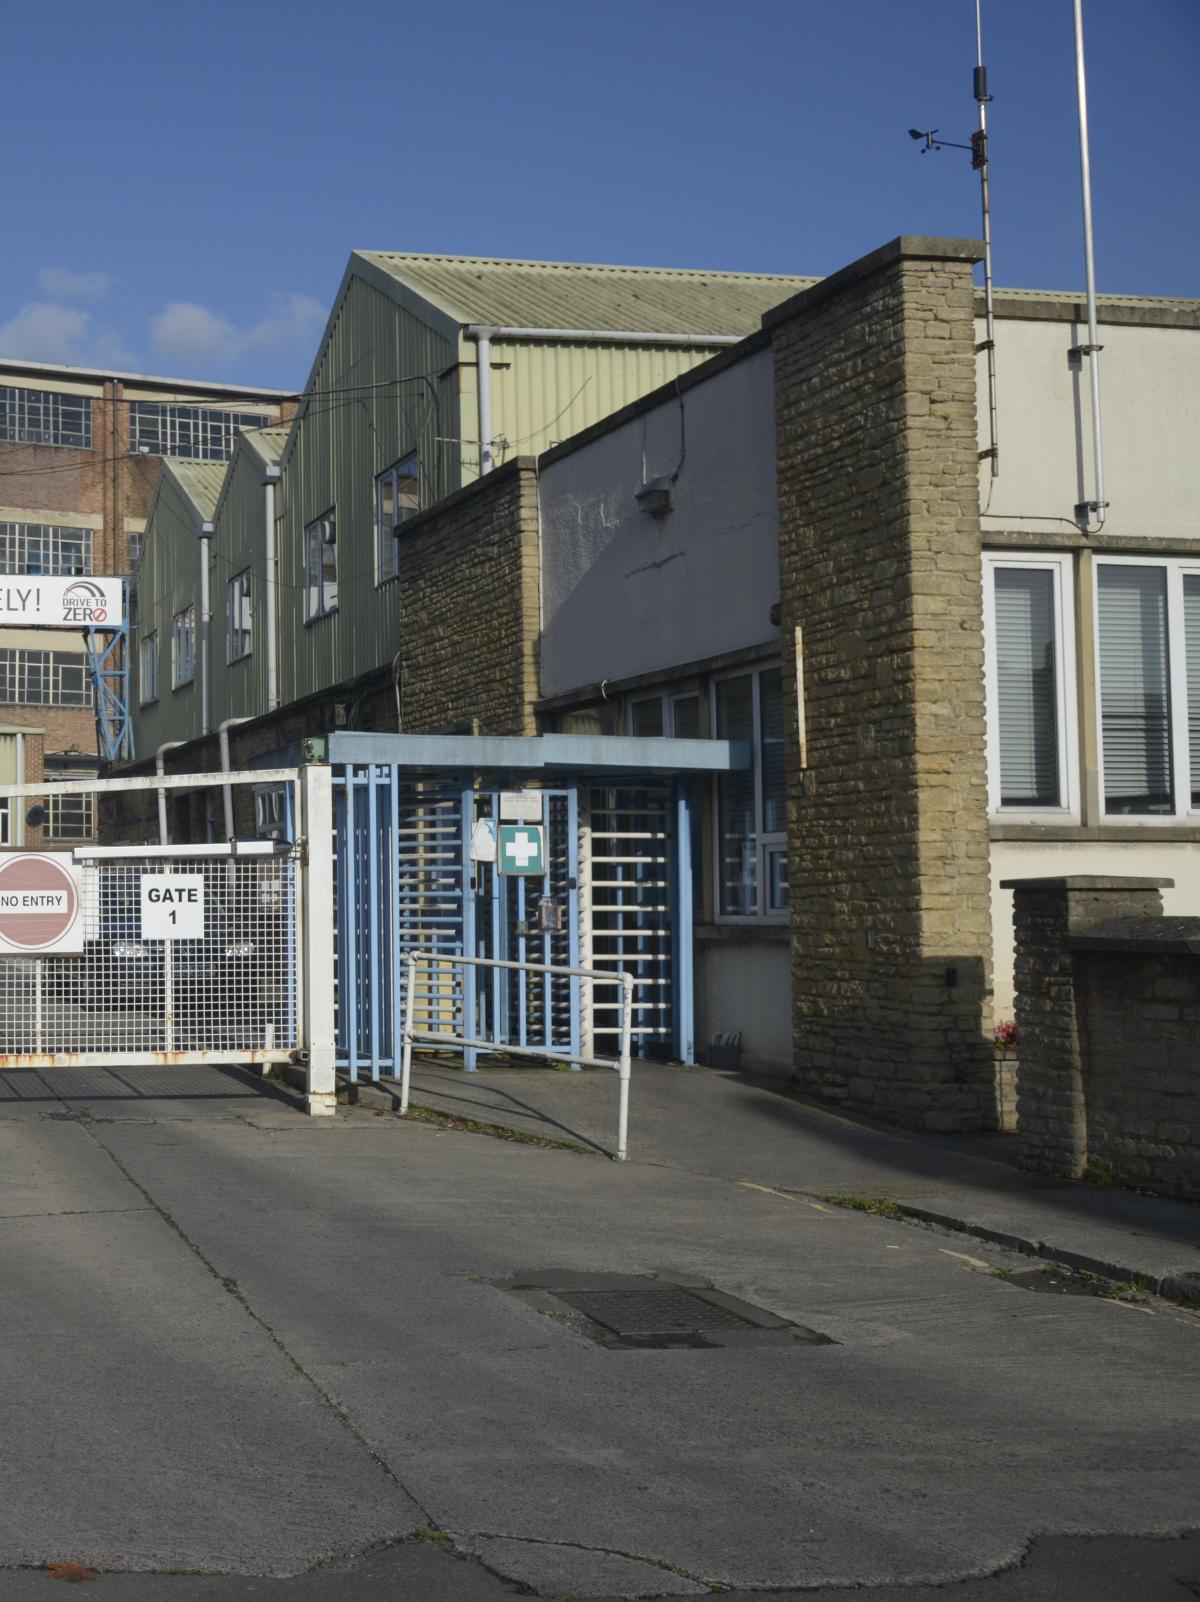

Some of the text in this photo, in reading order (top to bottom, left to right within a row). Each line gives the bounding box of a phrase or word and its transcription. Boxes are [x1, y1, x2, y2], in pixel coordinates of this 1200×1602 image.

[62, 598, 107, 607] DRIVE TO
[63, 607, 107, 622] ZERO
[1, 895, 63, 907] NO ENTRY
[148, 887, 198, 904] GATE
[168, 910, 177, 925] 1
